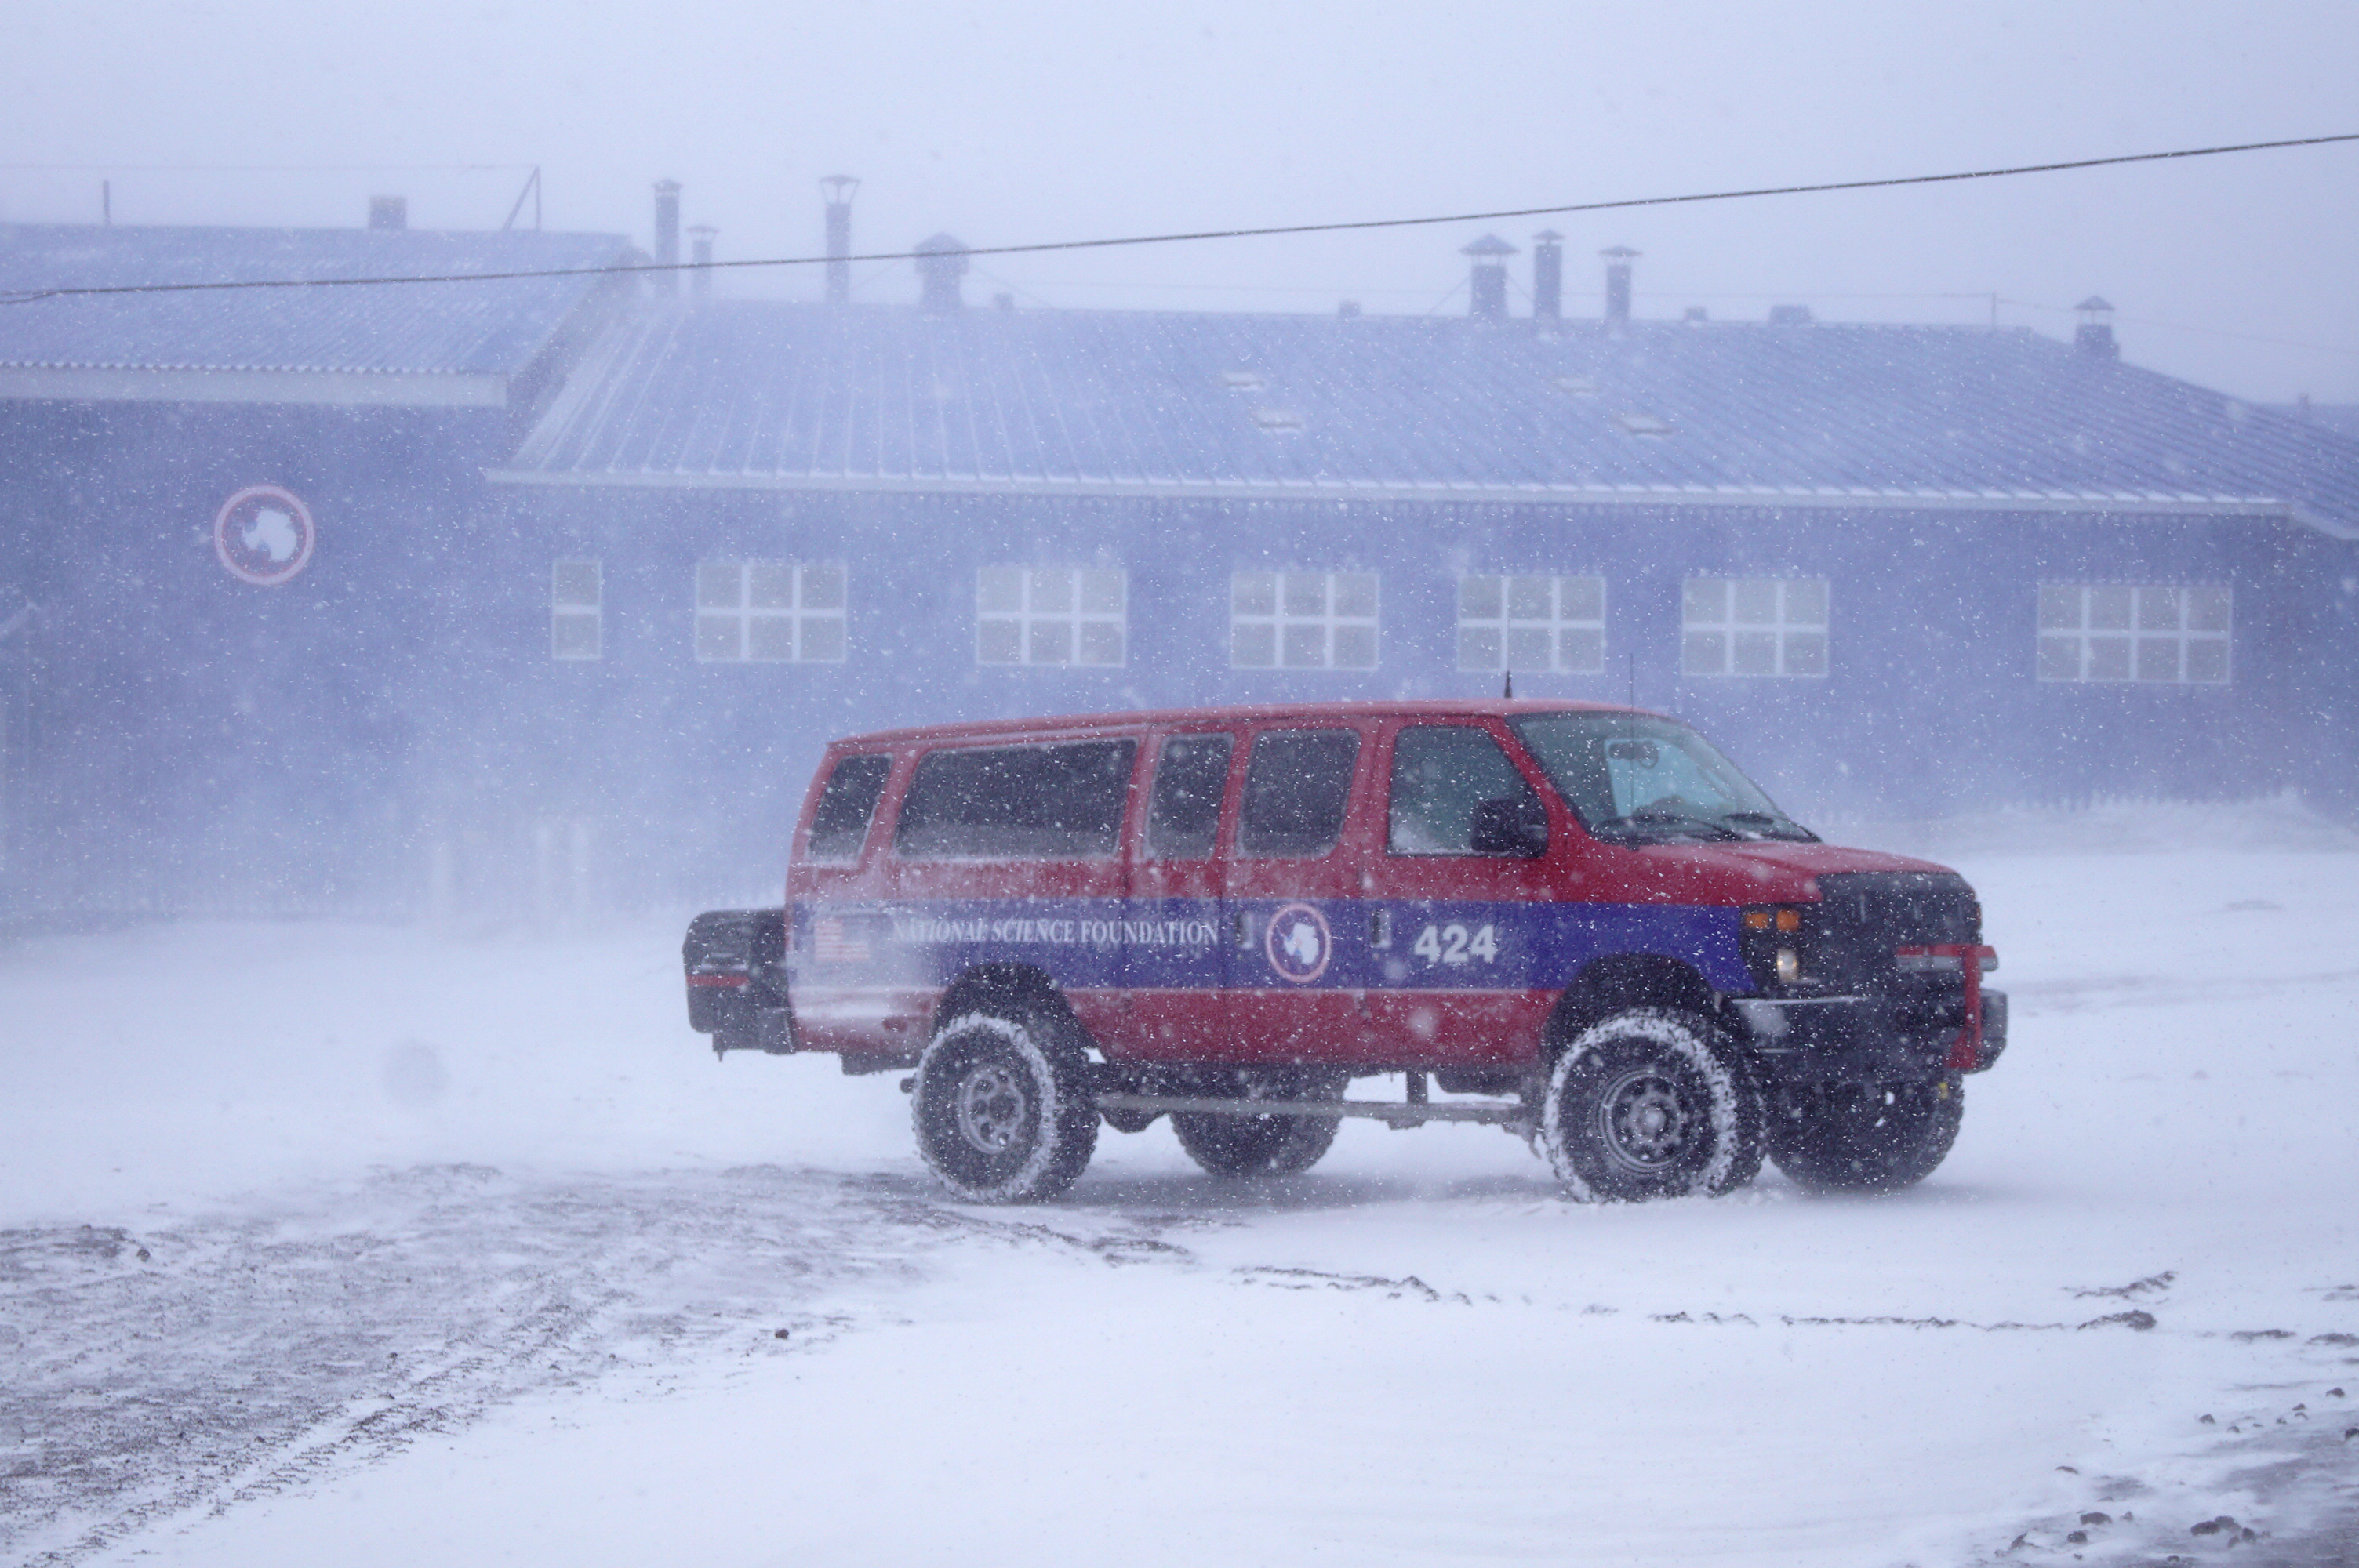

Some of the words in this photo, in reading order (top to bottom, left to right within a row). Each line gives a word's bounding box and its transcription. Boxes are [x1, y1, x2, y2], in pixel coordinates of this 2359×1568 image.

[892, 919, 985, 942] NATIONAL
[991, 920, 1074, 942] SCIENCE
[1079, 920, 1219, 944] FOUNDATION
[1414, 924, 1498, 964] 424
